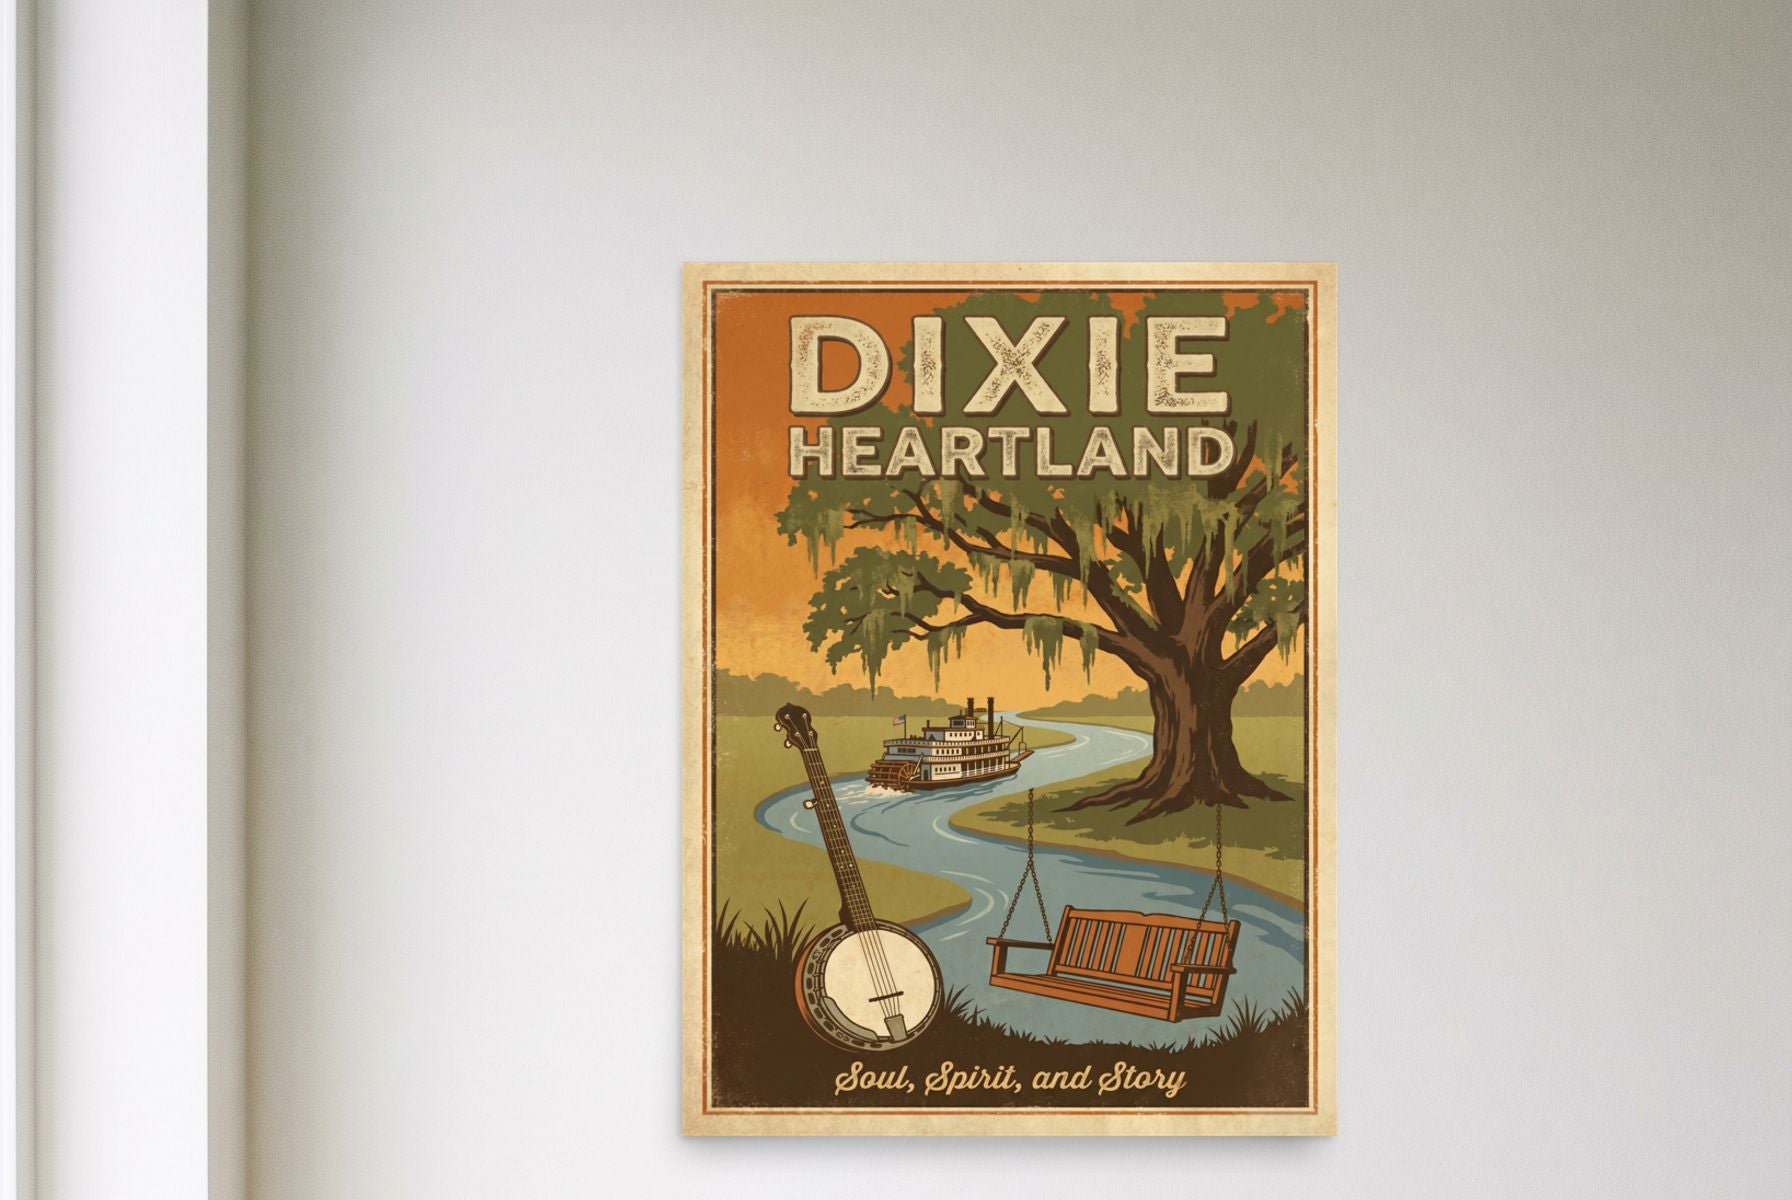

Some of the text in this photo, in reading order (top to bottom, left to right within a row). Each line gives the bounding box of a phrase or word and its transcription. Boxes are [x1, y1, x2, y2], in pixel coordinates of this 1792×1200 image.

[789, 315, 1230, 415] DIXIE
[788, 425, 1236, 479] HEARTLAND
[834, 1061, 1188, 1099] Soul, Spirit, and Story
